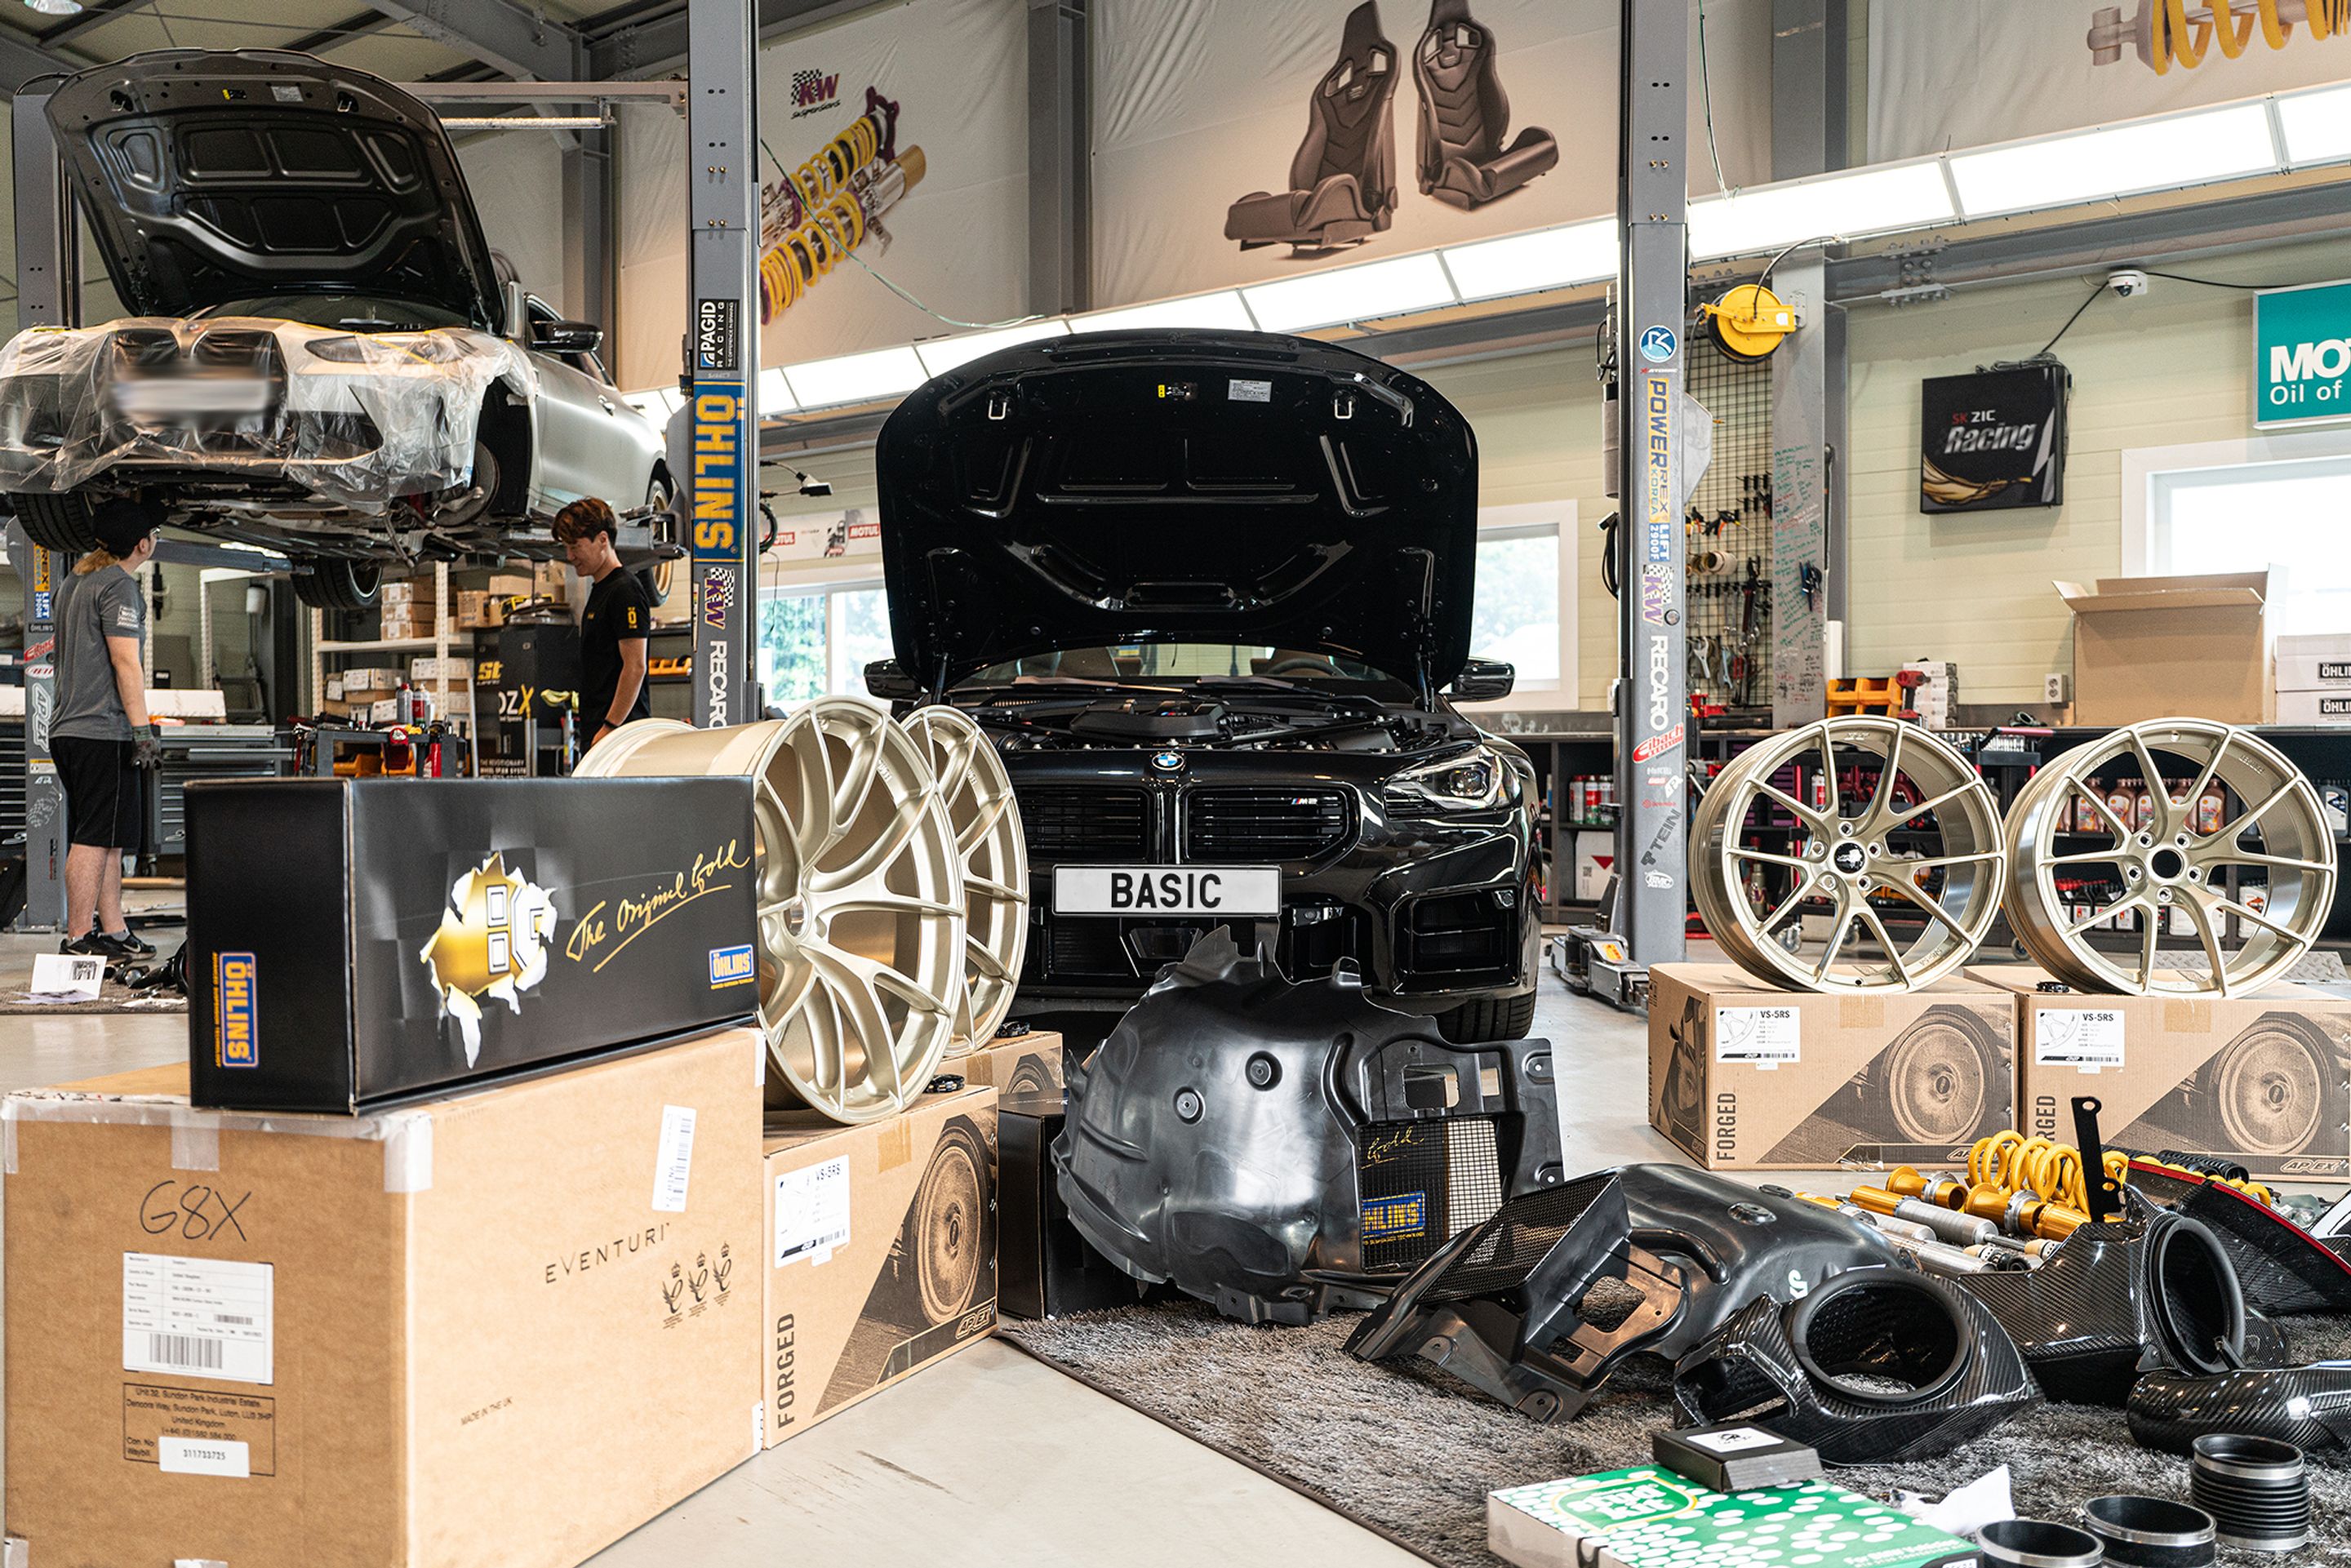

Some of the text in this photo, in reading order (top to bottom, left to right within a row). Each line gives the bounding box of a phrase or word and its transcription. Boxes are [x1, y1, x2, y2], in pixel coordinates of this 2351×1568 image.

[798, 73, 839, 107] KW
[700, 301, 716, 351] PAGID
[717, 301, 725, 367] RACING
[2270, 338, 2351, 383] MO
[2270, 379, 2343, 405] Oil of
[1952, 410, 1996, 424] SK ZIC
[1944, 422, 2038, 454] Racing
[696, 394, 744, 549] ÖHLINS
[1651, 469, 1659, 515] KOREA
[850, 526, 879, 538] MOTUL
[1660, 523, 1670, 561] LIFT
[704, 577, 726, 631] KW
[1642, 575, 1664, 627] KW
[1650, 635, 1669, 731] RECARO
[2322, 663, 2351, 677] ÖHLI
[2323, 699, 2351, 713] ÖHLI
[1633, 723, 1684, 763] Eibach
[1650, 809, 1682, 850] TEIN
[567, 839, 750, 962] The Original Gold
[1111, 873, 1221, 908] BASIC
[713, 950, 751, 979] ÖHLINS
[224, 962, 252, 1059] ÖHLINS
[1760, 1011, 1790, 1019] VS-5RS
[2082, 1013, 2114, 1022] VS-5RS
[1717, 1092, 1736, 1161] FORGED
[816, 1163, 841, 1181] VS-5RS
[2283, 1159, 2340, 1173] APEX
[140, 1179, 252, 1242] G8X
[1364, 1202, 1419, 1233] HLINS
[545, 1224, 664, 1284] EVENTURI
[777, 1313, 795, 1428] FORGED
[162, 1390, 189, 1401] Sundon
[190, 1393, 204, 1401] Park
[172, 1404, 199, 1414] Sundon
[171, 1416, 226, 1428] United Kingdom
[183, 1449, 226, 1461] 311733725
